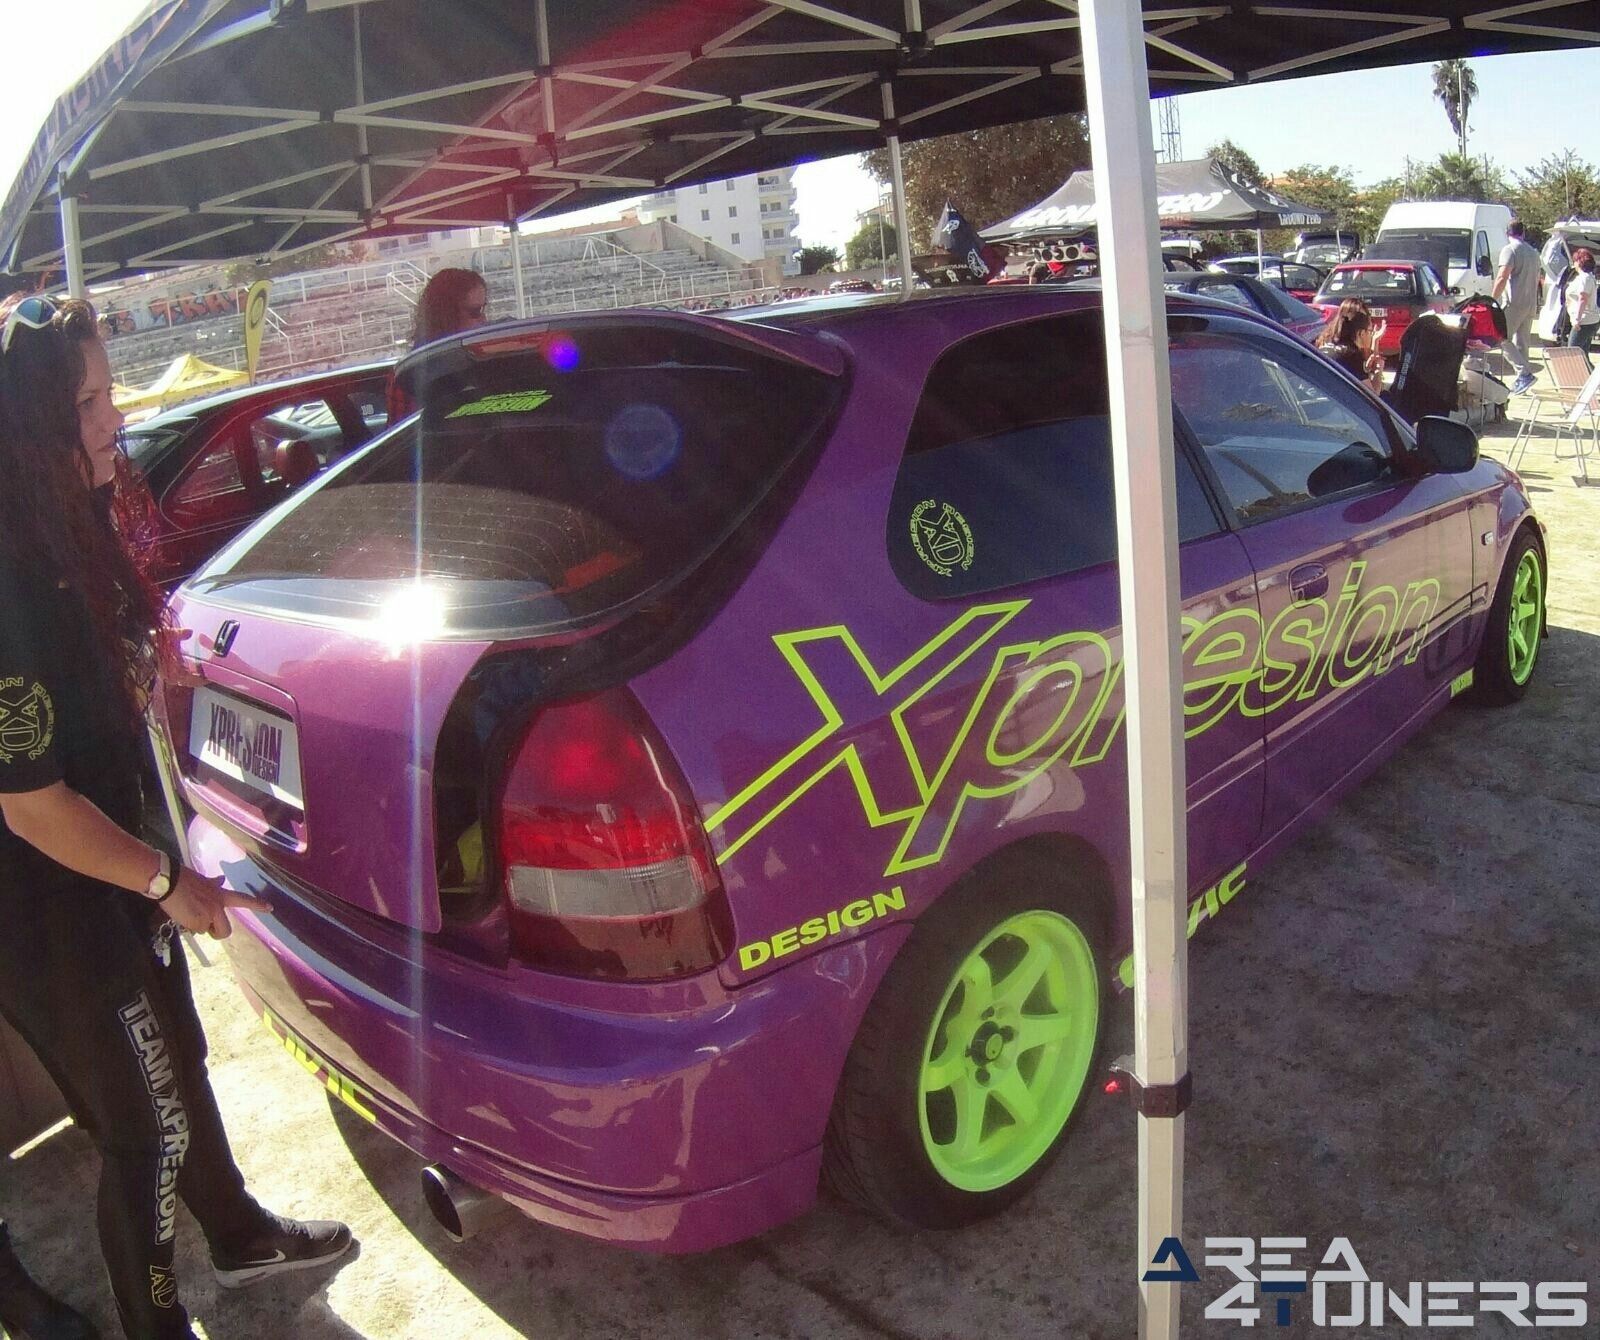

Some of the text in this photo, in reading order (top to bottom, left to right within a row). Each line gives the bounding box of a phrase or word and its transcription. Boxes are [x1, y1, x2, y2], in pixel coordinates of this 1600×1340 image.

[1278, 212, 1322, 226] GROUND ZERO
[739, 886, 906, 971] DESIGN
[118, 988, 175, 1094] TEAM
